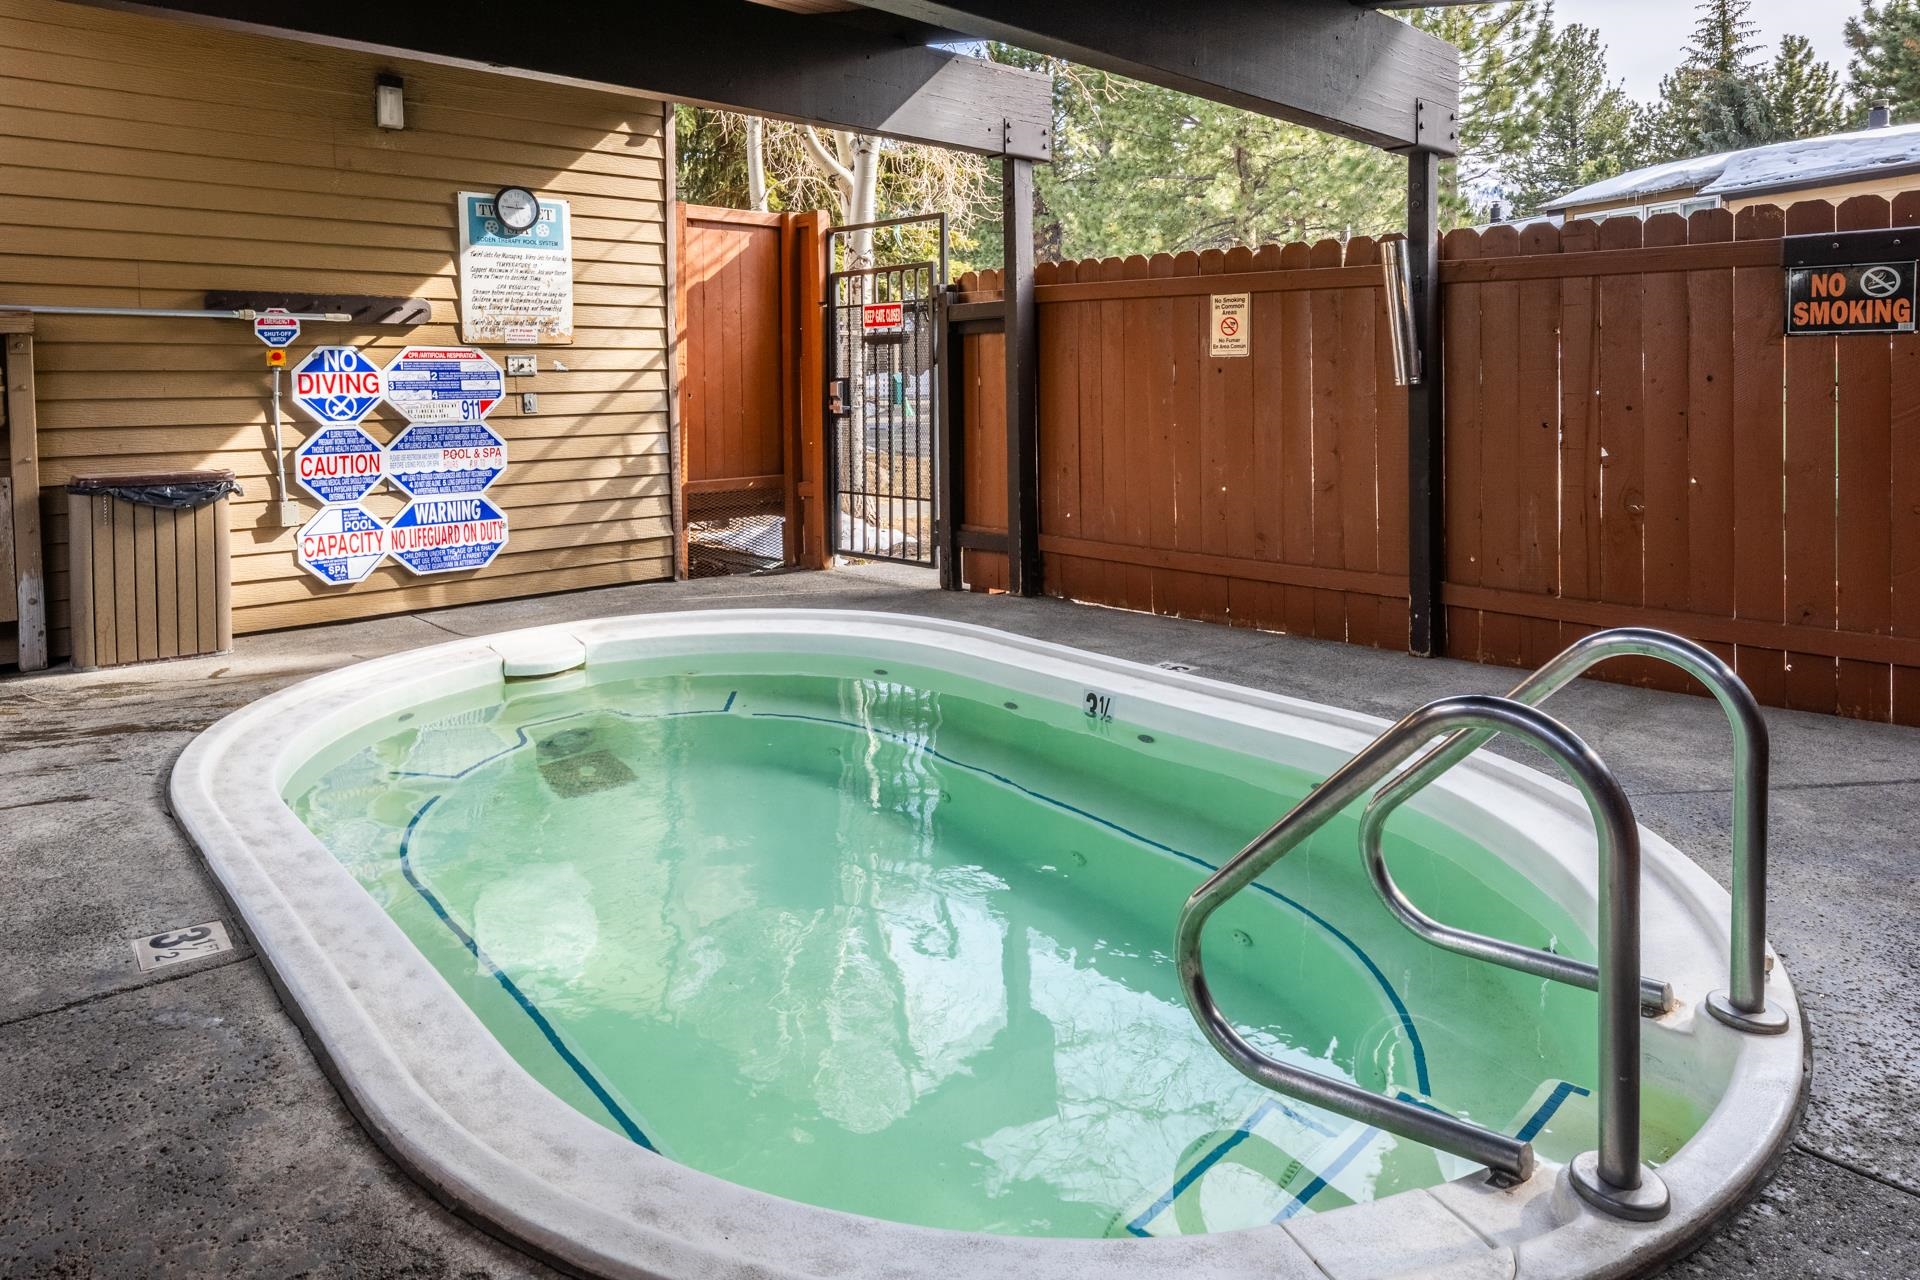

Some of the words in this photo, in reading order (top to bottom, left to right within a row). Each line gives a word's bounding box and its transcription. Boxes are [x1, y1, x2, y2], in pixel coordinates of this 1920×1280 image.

[1811, 272, 1846, 298] NO
[876, 309, 886, 322] GATE
[886, 308, 900, 323] CLOSED
[1793, 298, 1910, 326] SMOKING
[324, 350, 357, 372] NO
[298, 373, 380, 394] DIVING
[462, 400, 480, 420] 911
[443, 449, 471, 459] POOL
[474, 448, 480, 458] &
[483, 448, 501, 458] SPA
[301, 454, 380, 477] CAUTION
[414, 500, 480, 524] WARNING
[344, 520, 375, 531] POOL
[391, 529, 405, 550] NO
[410, 524, 460, 548] LIFEGUARD
[464, 523, 477, 542] ON
[480, 521, 504, 541] DUTY
[304, 531, 383, 557] CAPACITY
[404, 551, 428, 560] CHILDREN
[443, 554, 462, 562] WITHOUT
[458, 558, 485, 567] ATTENDANCE
[328, 566, 347, 575] SPA
